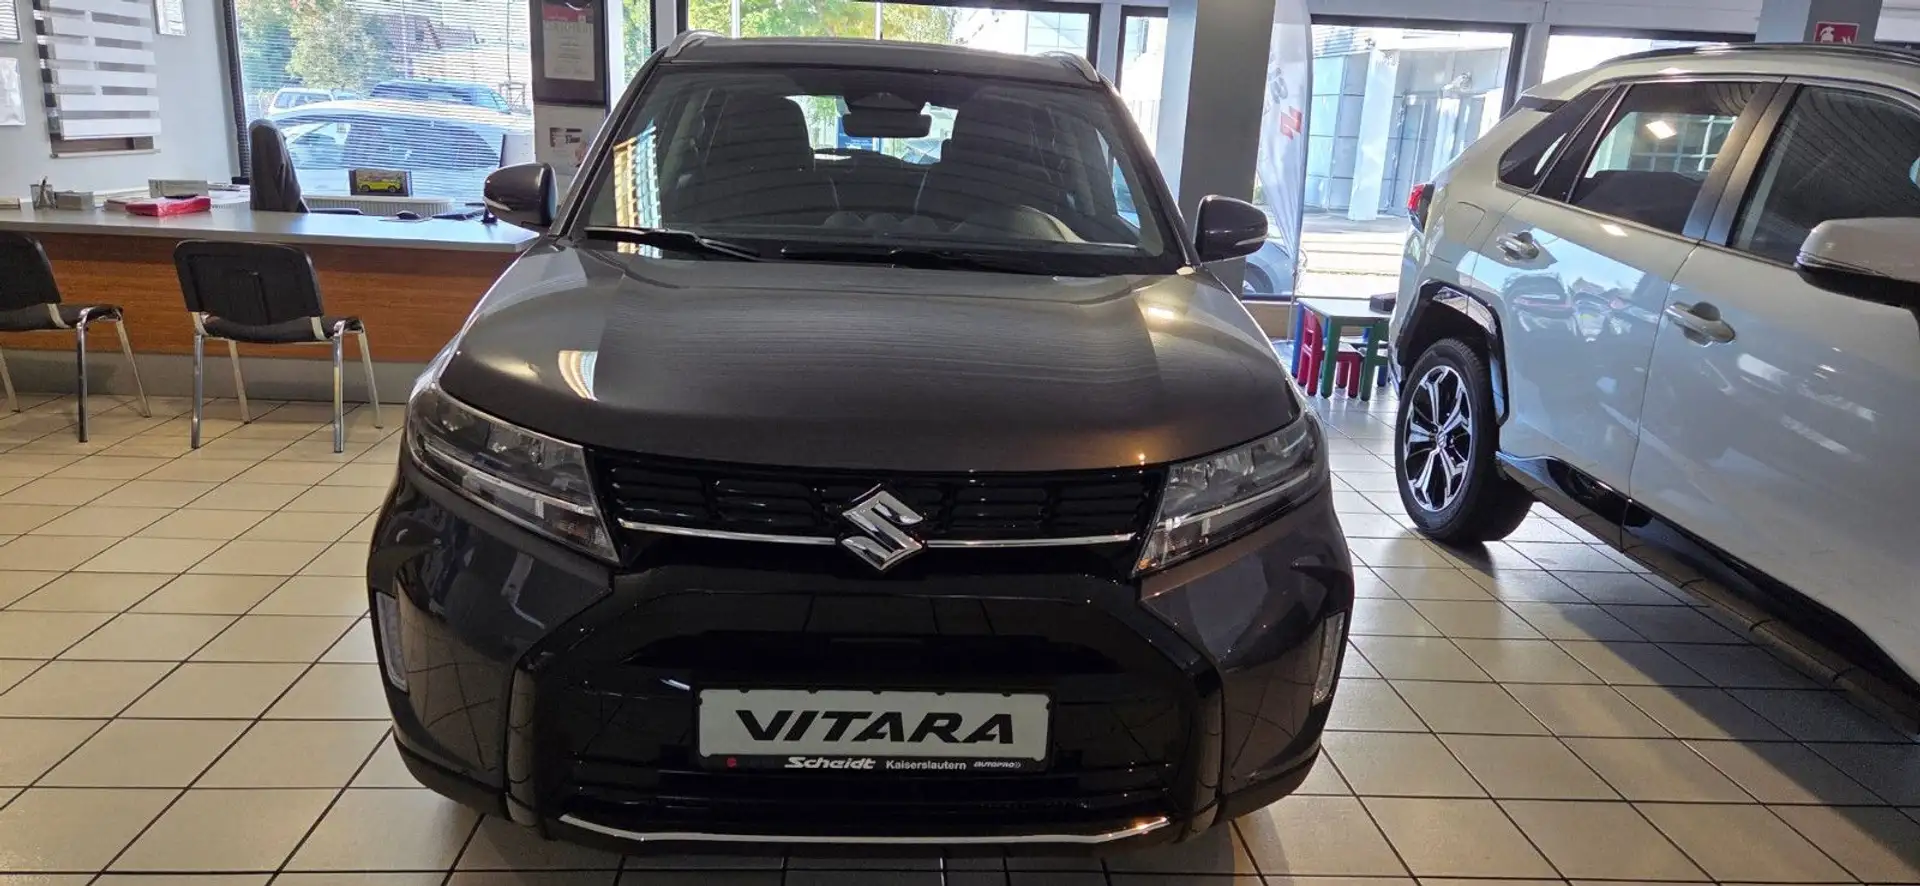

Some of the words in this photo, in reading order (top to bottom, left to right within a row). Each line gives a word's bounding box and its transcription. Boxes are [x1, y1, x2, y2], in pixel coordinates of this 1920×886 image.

[735, 709, 1014, 745] VITARA
[784, 756, 876, 770] Scheidt
[886, 759, 967, 771] Kaiserslautern
